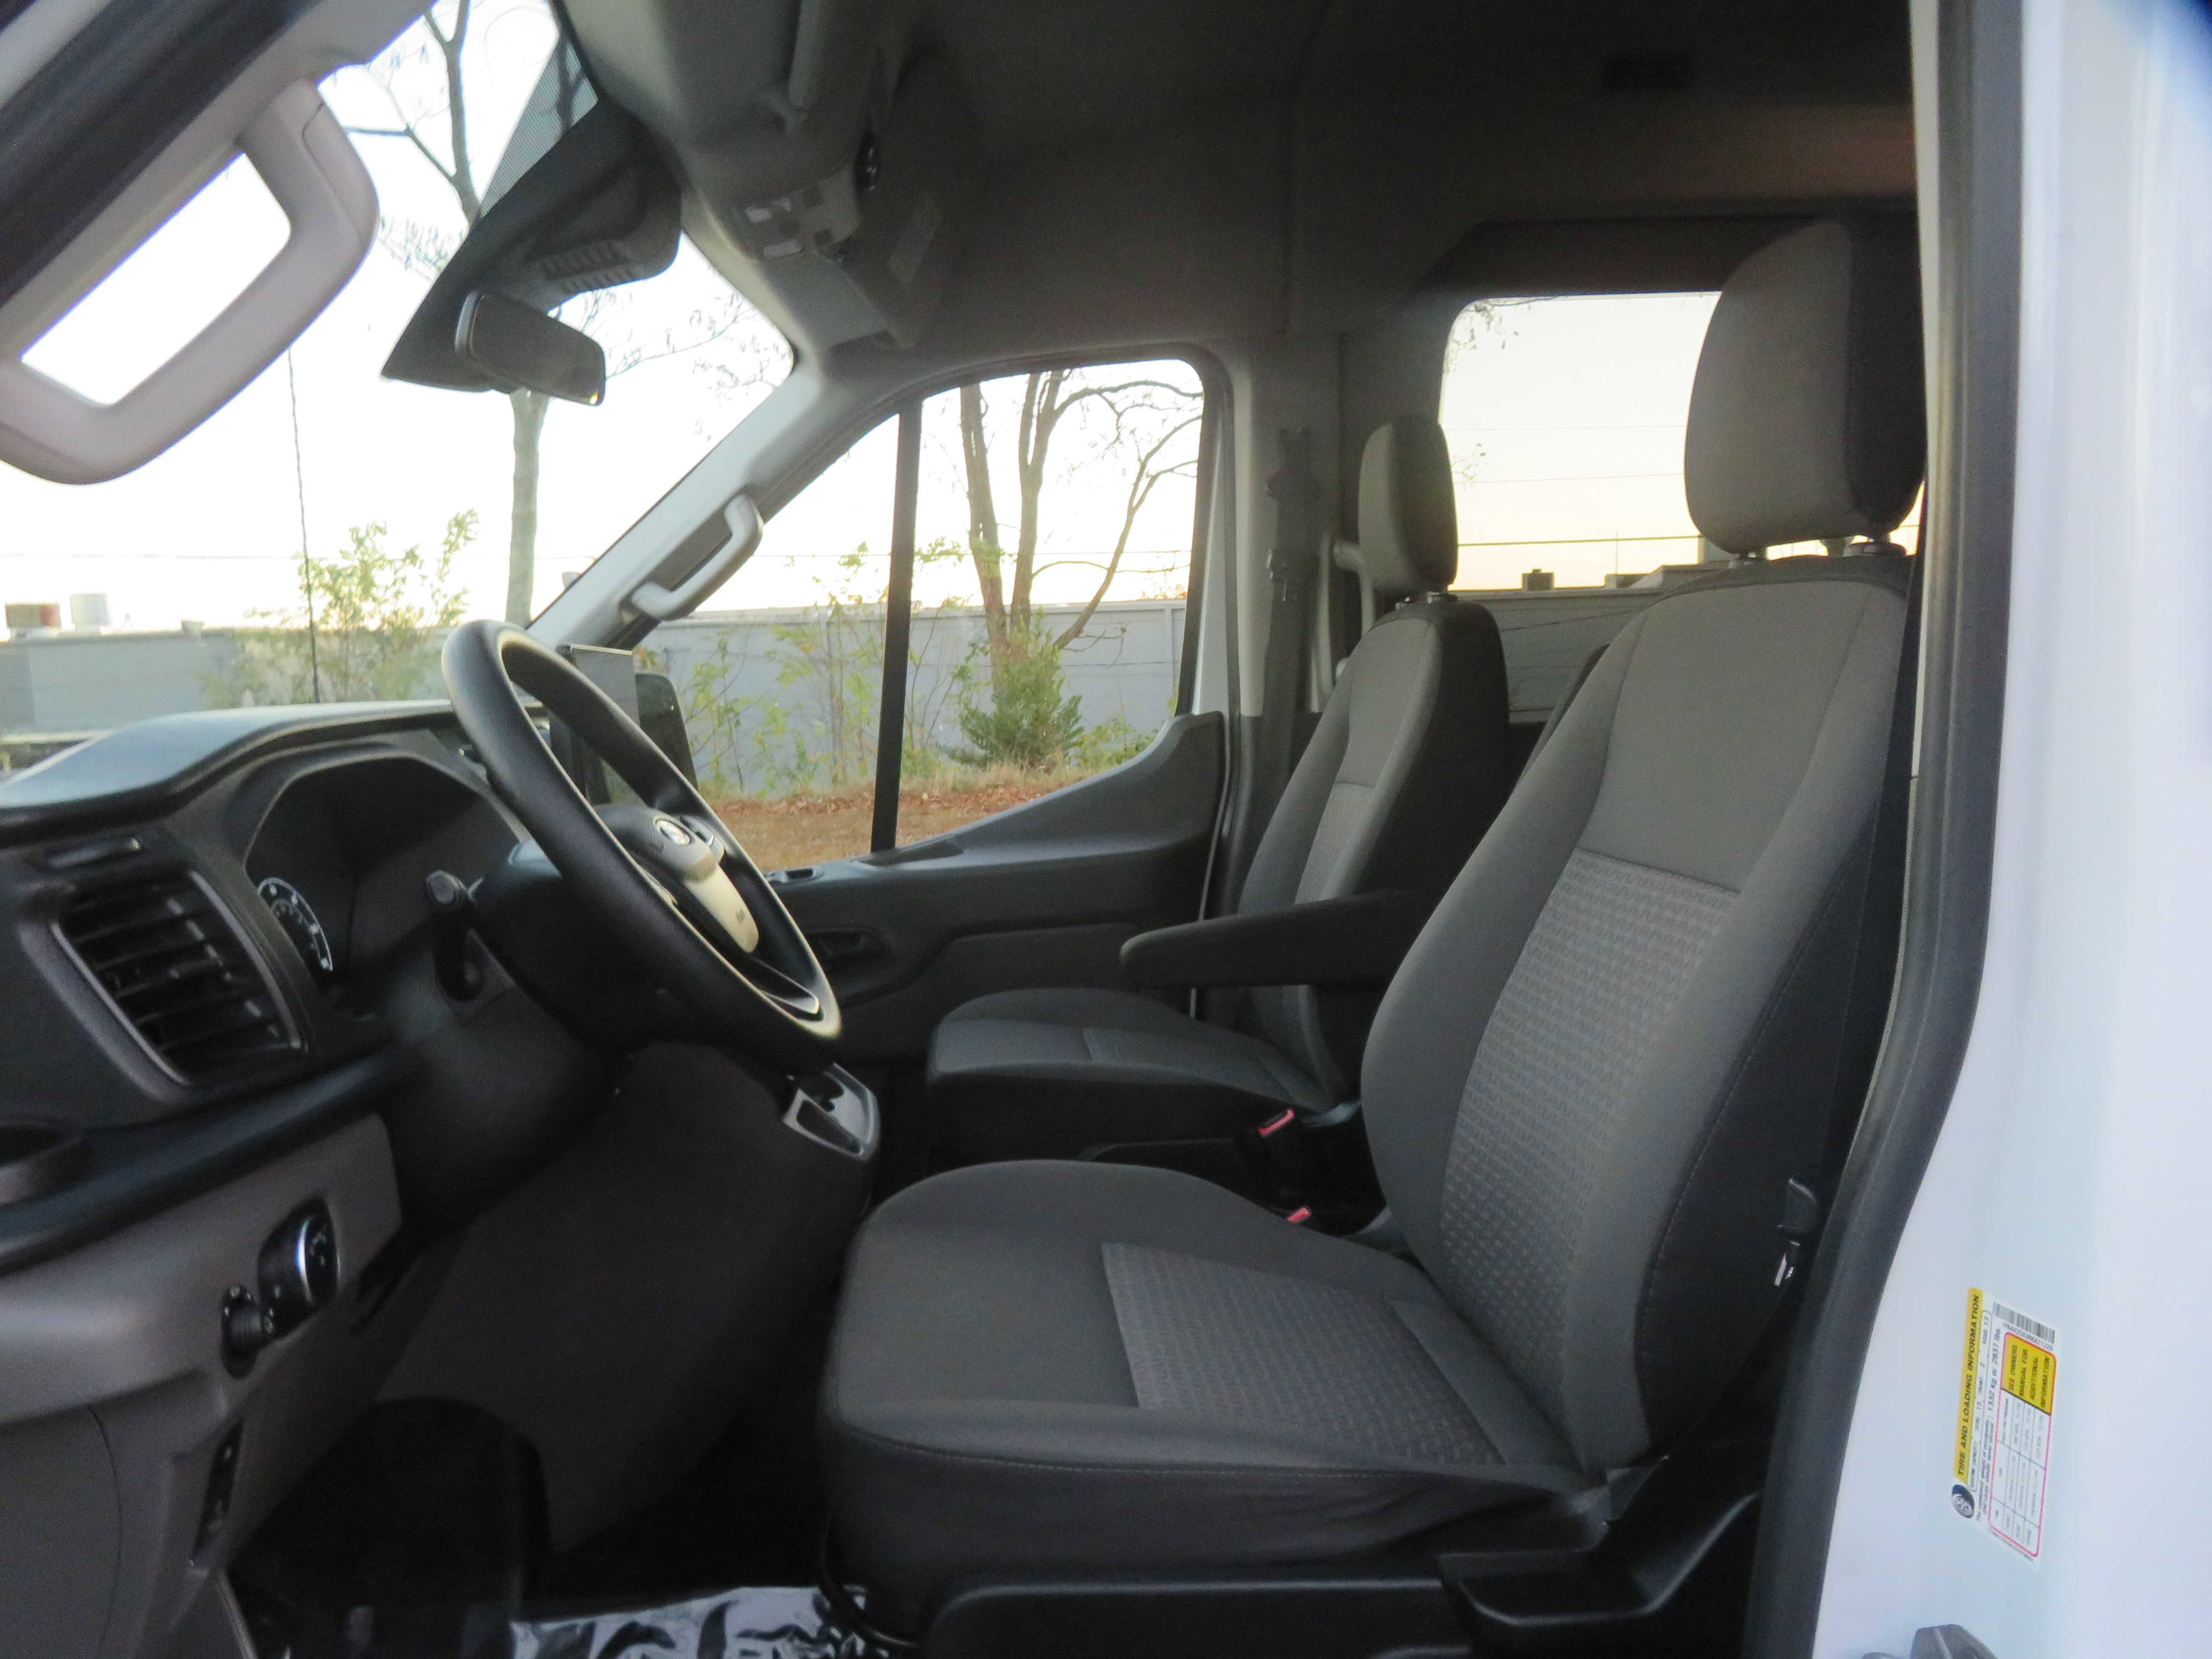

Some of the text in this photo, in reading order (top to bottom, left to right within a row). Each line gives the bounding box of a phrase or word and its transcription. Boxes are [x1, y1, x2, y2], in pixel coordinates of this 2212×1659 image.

[1967, 1293, 1979, 1372] INFORMATION
[1989, 1376, 1997, 1390] kg
[1991, 1366, 1997, 1377] or
[2018, 1365, 2027, 1398] MANUAL
[2029, 1355, 2039, 1401] ADDITIONAL
[2040, 1354, 2051, 1410] INFORMATION
[1963, 1372, 1972, 1423] LOADING
